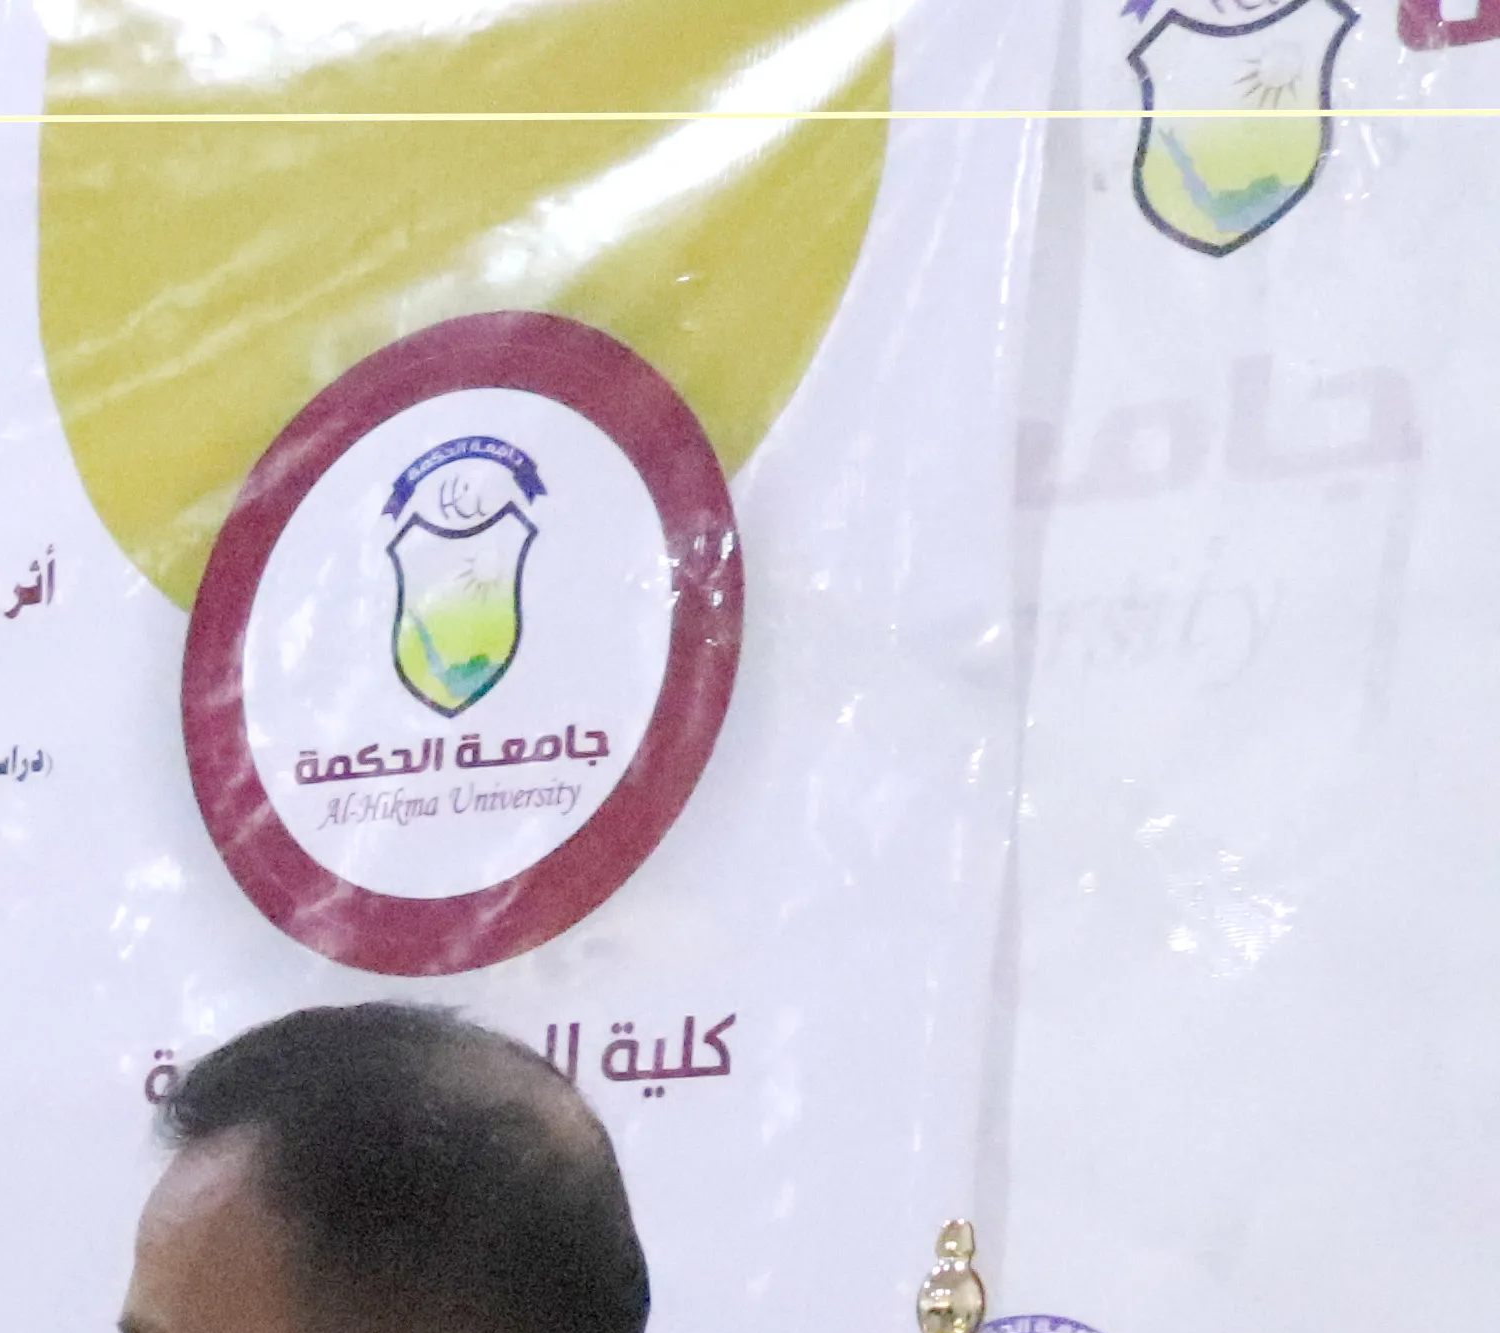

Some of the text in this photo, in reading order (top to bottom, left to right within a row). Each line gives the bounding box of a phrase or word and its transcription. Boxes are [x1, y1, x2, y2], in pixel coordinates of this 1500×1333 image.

[4, 543, 56, 619] أثر
[295, 722, 611, 786] جامعة الحكمة
[318, 777, 583, 831] Al-Hikma University
[602, 1013, 738, 1099] كلية
